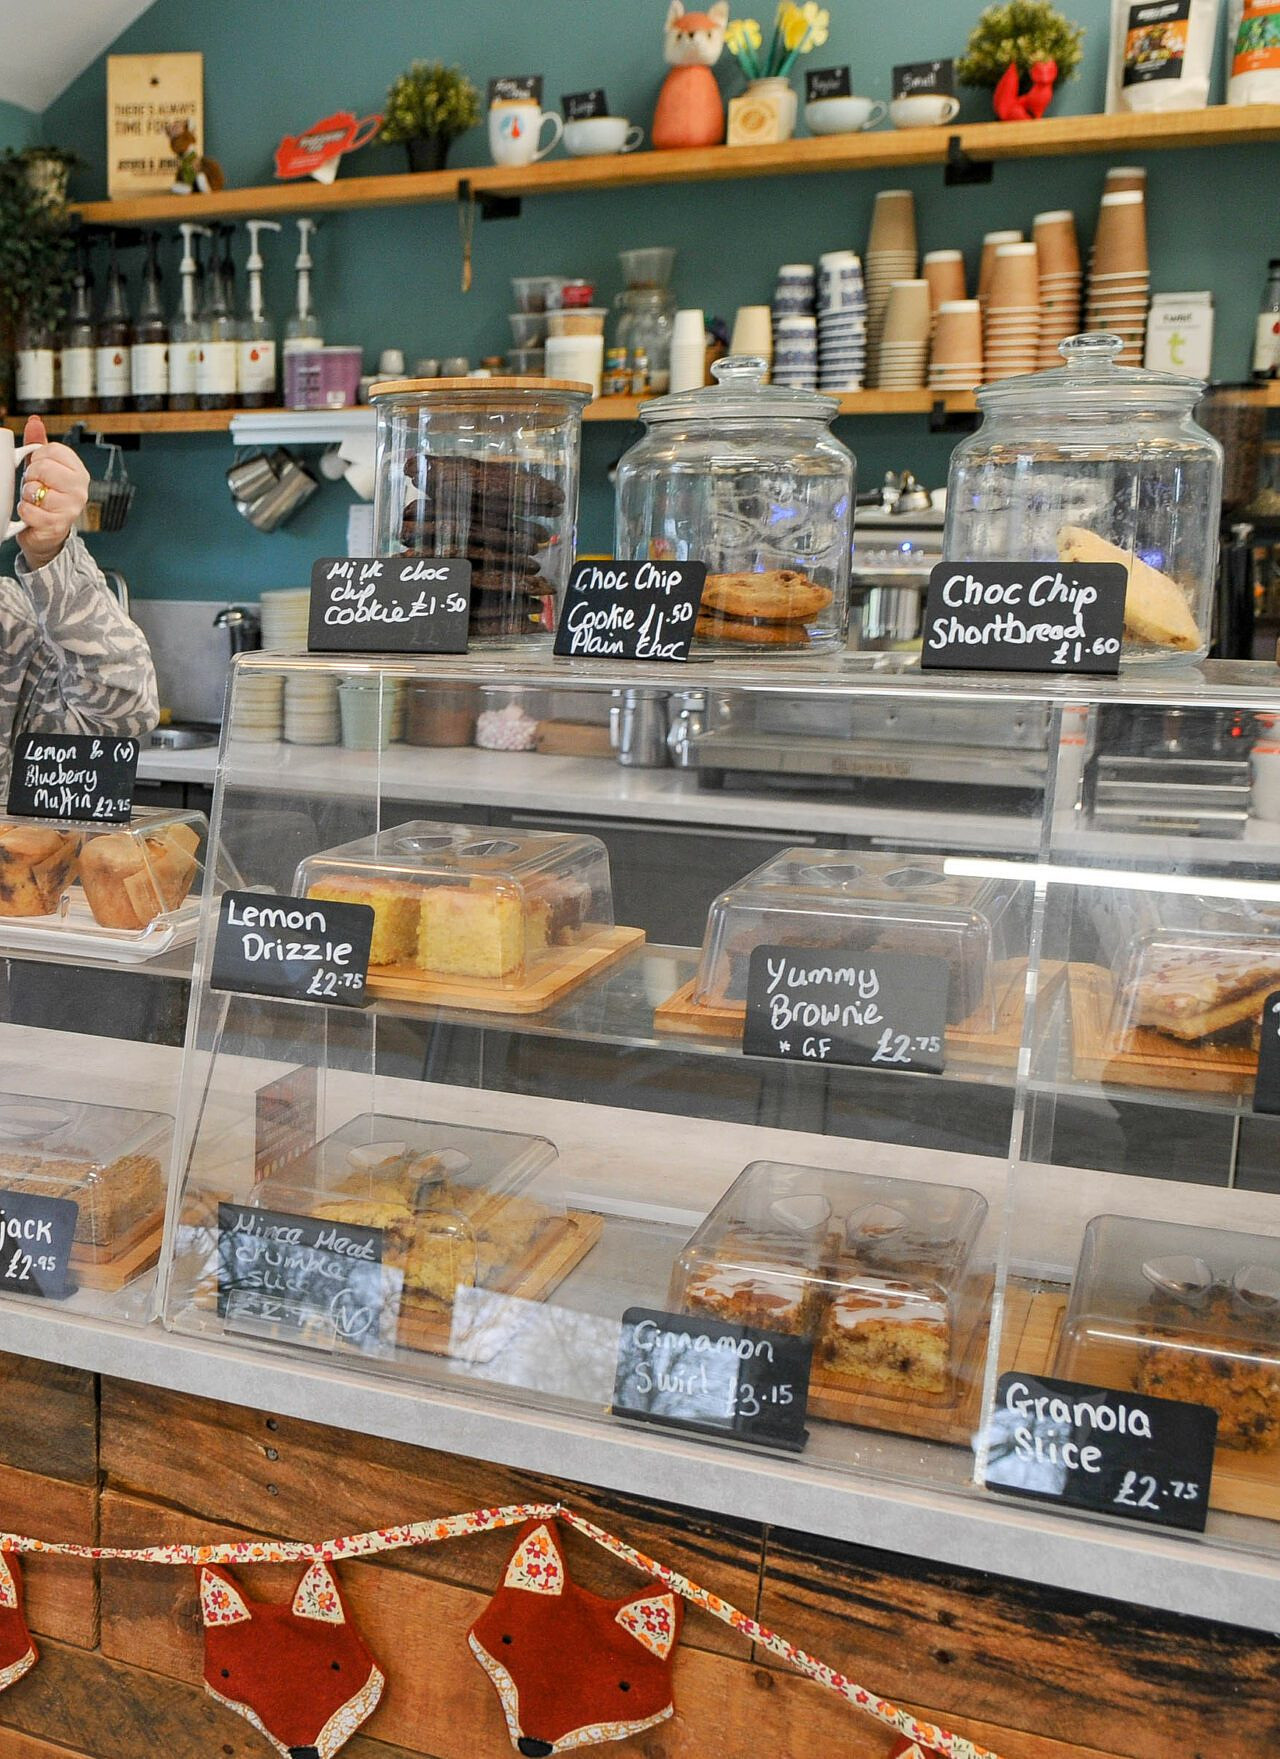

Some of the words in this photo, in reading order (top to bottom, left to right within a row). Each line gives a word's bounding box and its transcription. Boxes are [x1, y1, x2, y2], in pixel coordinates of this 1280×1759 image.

[574, 566, 629, 592] Choc
[634, 562, 683, 595] Chip
[942, 574, 1024, 608] Choc
[1028, 572, 1098, 615] Chip
[408, 591, 467, 618] £1.50
[567, 601, 636, 633] Cookie
[570, 627, 624, 654] Plain
[928, 611, 1086, 649] Shortbread
[1051, 637, 1120, 665] £1.60
[24, 740, 77, 763] Lemon
[89, 739, 104, 760] &
[24, 763, 98, 793] Blueberry
[34, 785, 92, 816] Muffin
[92, 796, 131, 818] £2.95
[227, 899, 327, 933] Lemon
[242, 933, 353, 965] Drizzle
[306, 968, 364, 997] £2.75
[766, 958, 880, 999] Yummy
[770, 994, 883, 1030] Brownie
[871, 1028, 941, 1063] £2.75
[232, 1213, 304, 1246] Mince
[313, 1229, 376, 1261] Meat
[4, 1248, 57, 1280] £2.95
[632, 1319, 774, 1363] Cinnamon
[634, 1361, 708, 1395] Swirl
[1005, 1382, 1152, 1439] Granola
[1013, 1427, 1102, 1473] Slice
[1113, 1470, 1199, 1511] £2.75
